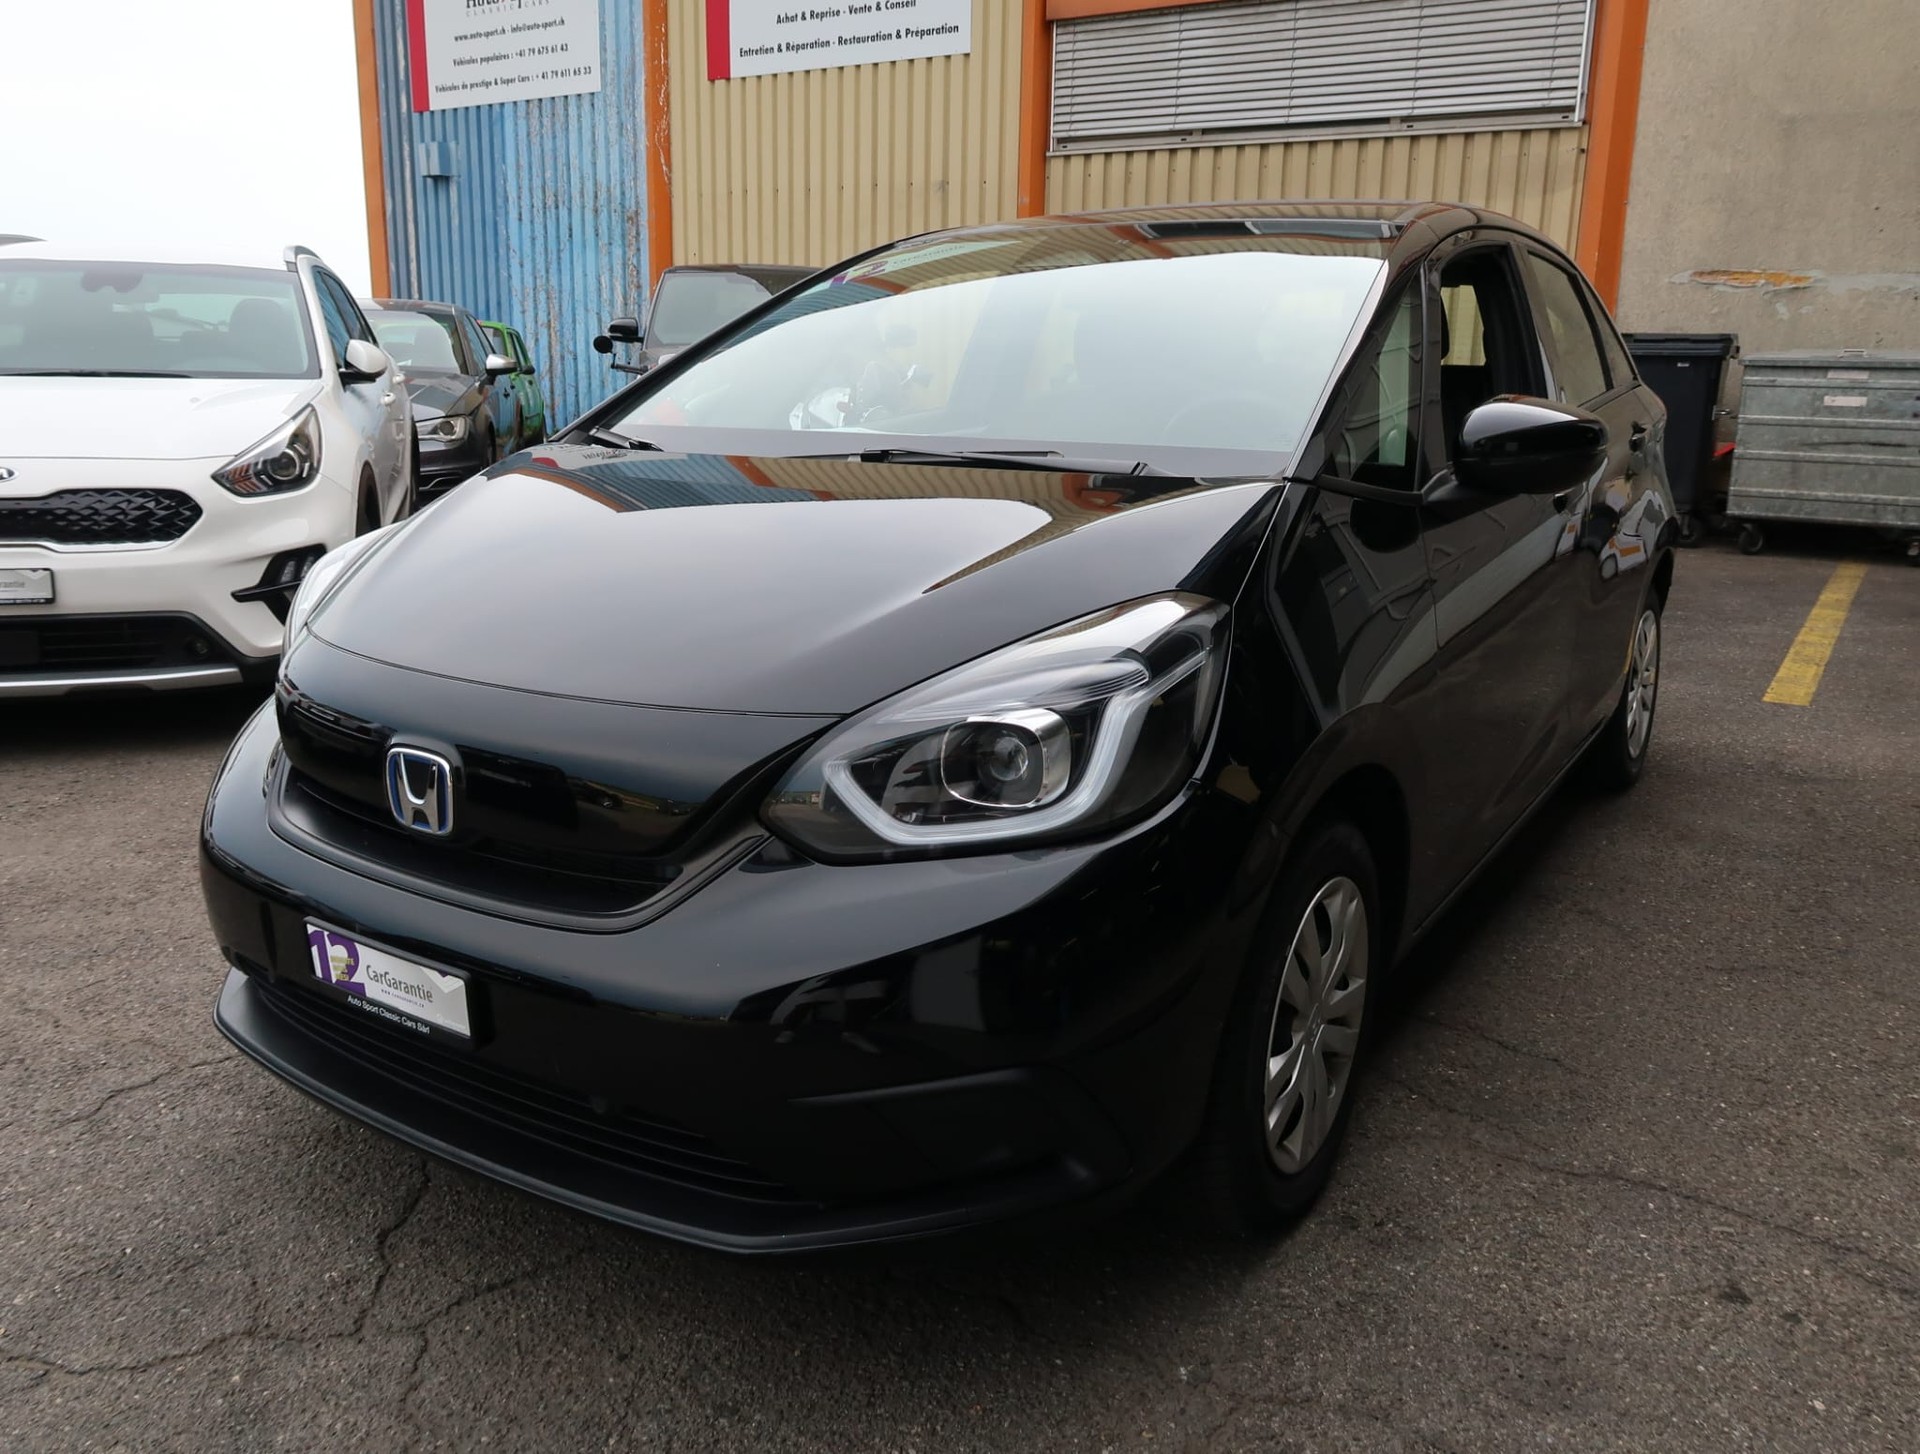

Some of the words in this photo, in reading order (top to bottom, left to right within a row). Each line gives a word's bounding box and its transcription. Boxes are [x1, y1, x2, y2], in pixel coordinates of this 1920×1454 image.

[776, 12, 798, 25] Achat
[800, 11, 807, 21] &
[810, 7, 841, 22] Reprise
[848, 4, 872, 15] Vente
[875, 1, 882, 12] &
[885, 0, 916, 10] Conseil
[454, 26, 506, 42] www.auto-sport.ch
[511, 16, 565, 33] info@auto-sport.ch
[740, 44, 774, 57] Entretien
[777, 43, 783, 53] &
[786, 37, 830, 54] Réparation
[838, 30, 893, 46] Restauration
[895, 29, 902, 40] &
[905, 22, 959, 40] Préparation
[528, 47, 536, 56] 79
[551, 45, 558, 54] 61
[470, 78, 492, 91] prestige
[494, 77, 499, 86] &
[500, 75, 516, 87] Super
[518, 74, 530, 83] Cars
[541, 71, 549, 80] 41
[550, 70, 559, 79] 79
[560, 69, 571, 78] 611
[583, 66, 592, 75] 33
[308, 930, 367, 997] 12
[366, 965, 433, 1004] CarGarantie
[347, 995, 362, 1008] Auto
[362, 999, 379, 1014] Sport
[379, 1008, 401, 1023] Classic
[401, 1017, 416, 1029] Cars
